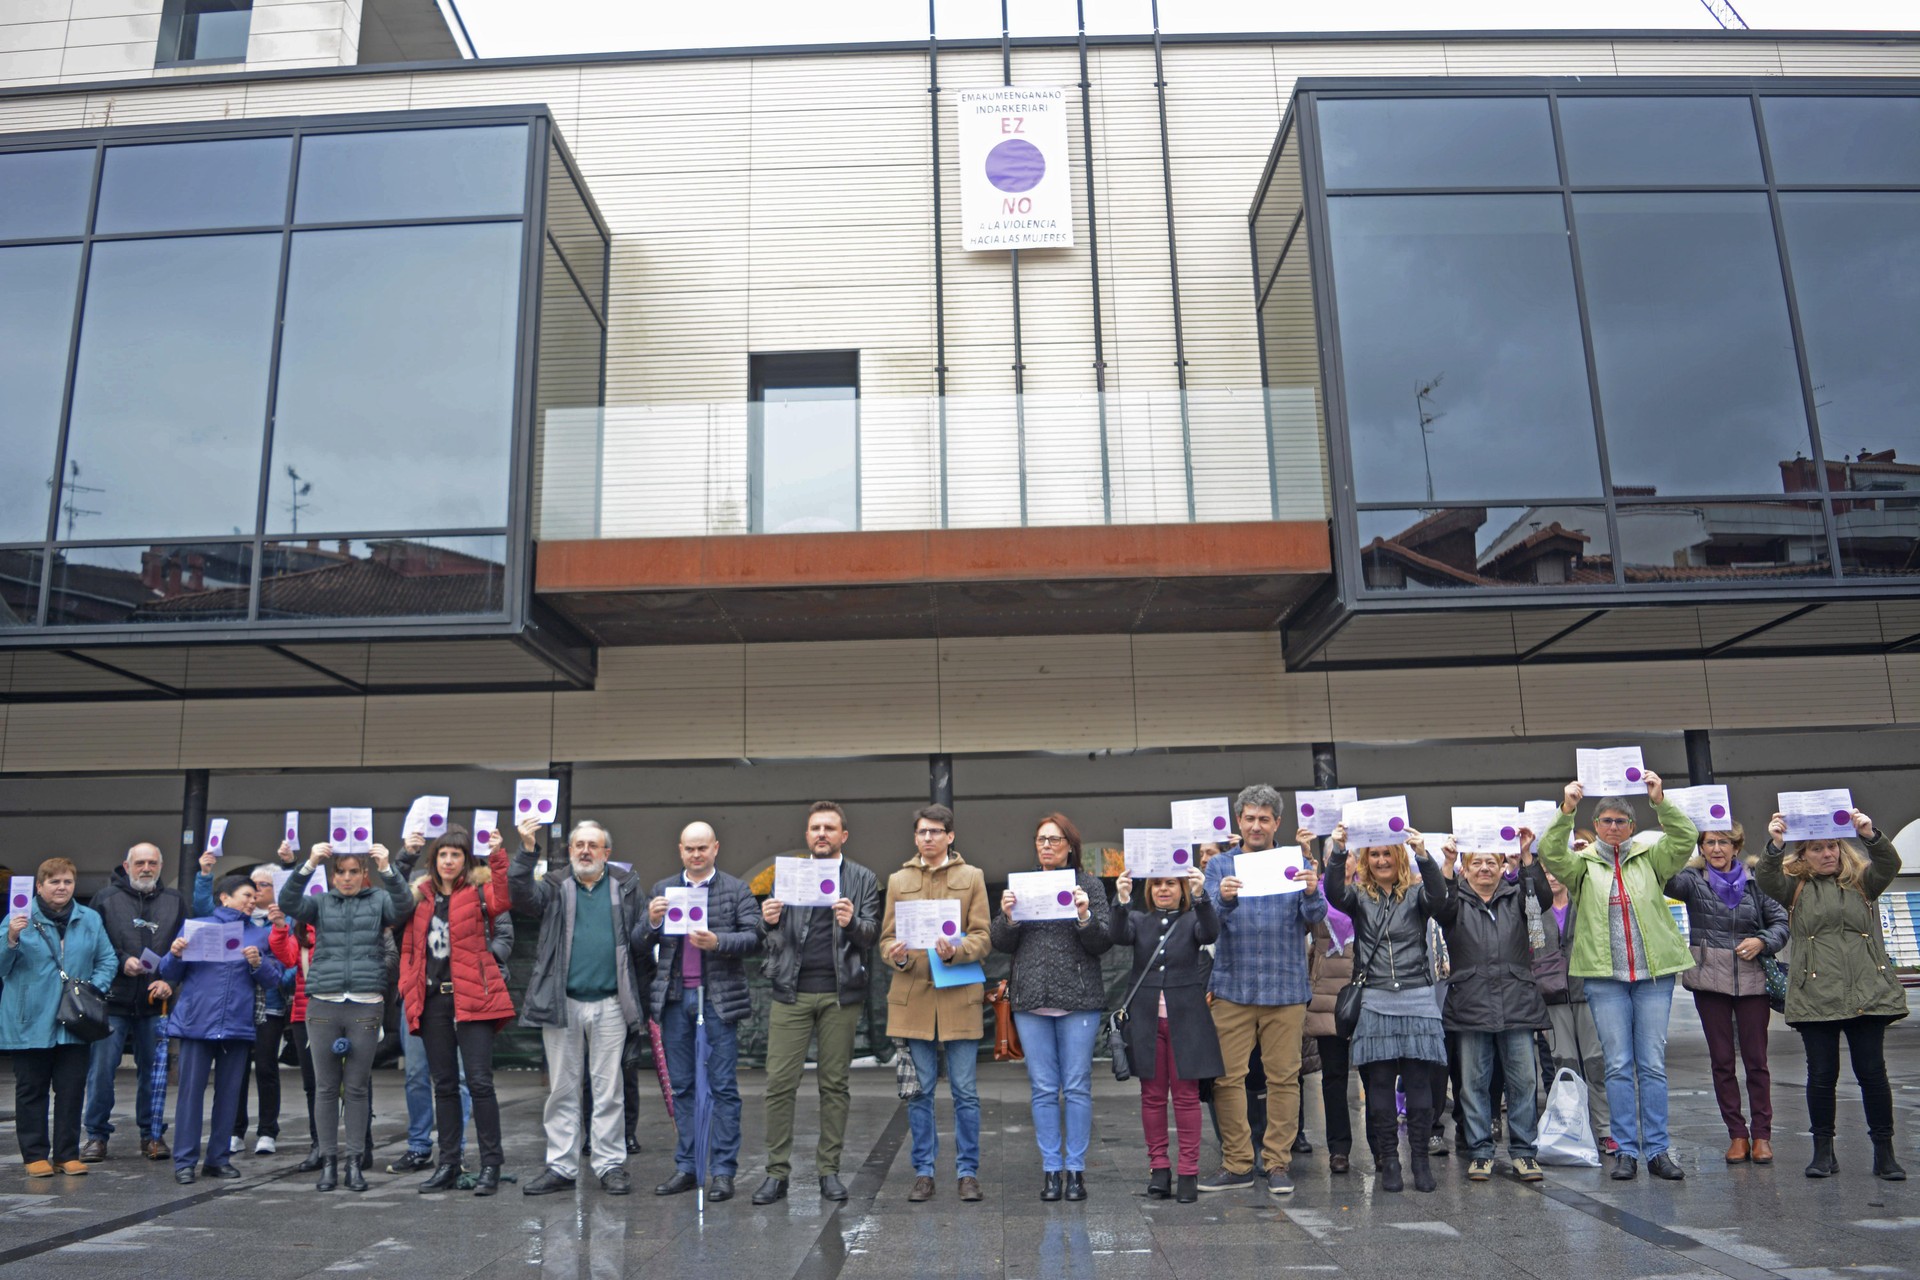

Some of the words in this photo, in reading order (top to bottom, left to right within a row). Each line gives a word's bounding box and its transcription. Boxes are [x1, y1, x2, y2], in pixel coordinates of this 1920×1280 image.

[962, 90, 1061, 102] EMAKUMEENGANAKO
[976, 104, 1048, 115] INDARKERIARI
[1001, 117, 1025, 134] EZ
[1002, 197, 1032, 214] NO
[988, 220, 1000, 230] LA
[1003, 219, 1057, 229] VIOLENCIA
[970, 235, 1000, 245] HACIA
[1002, 234, 1020, 243] LAS
[1023, 233, 1067, 243] MUJERES
